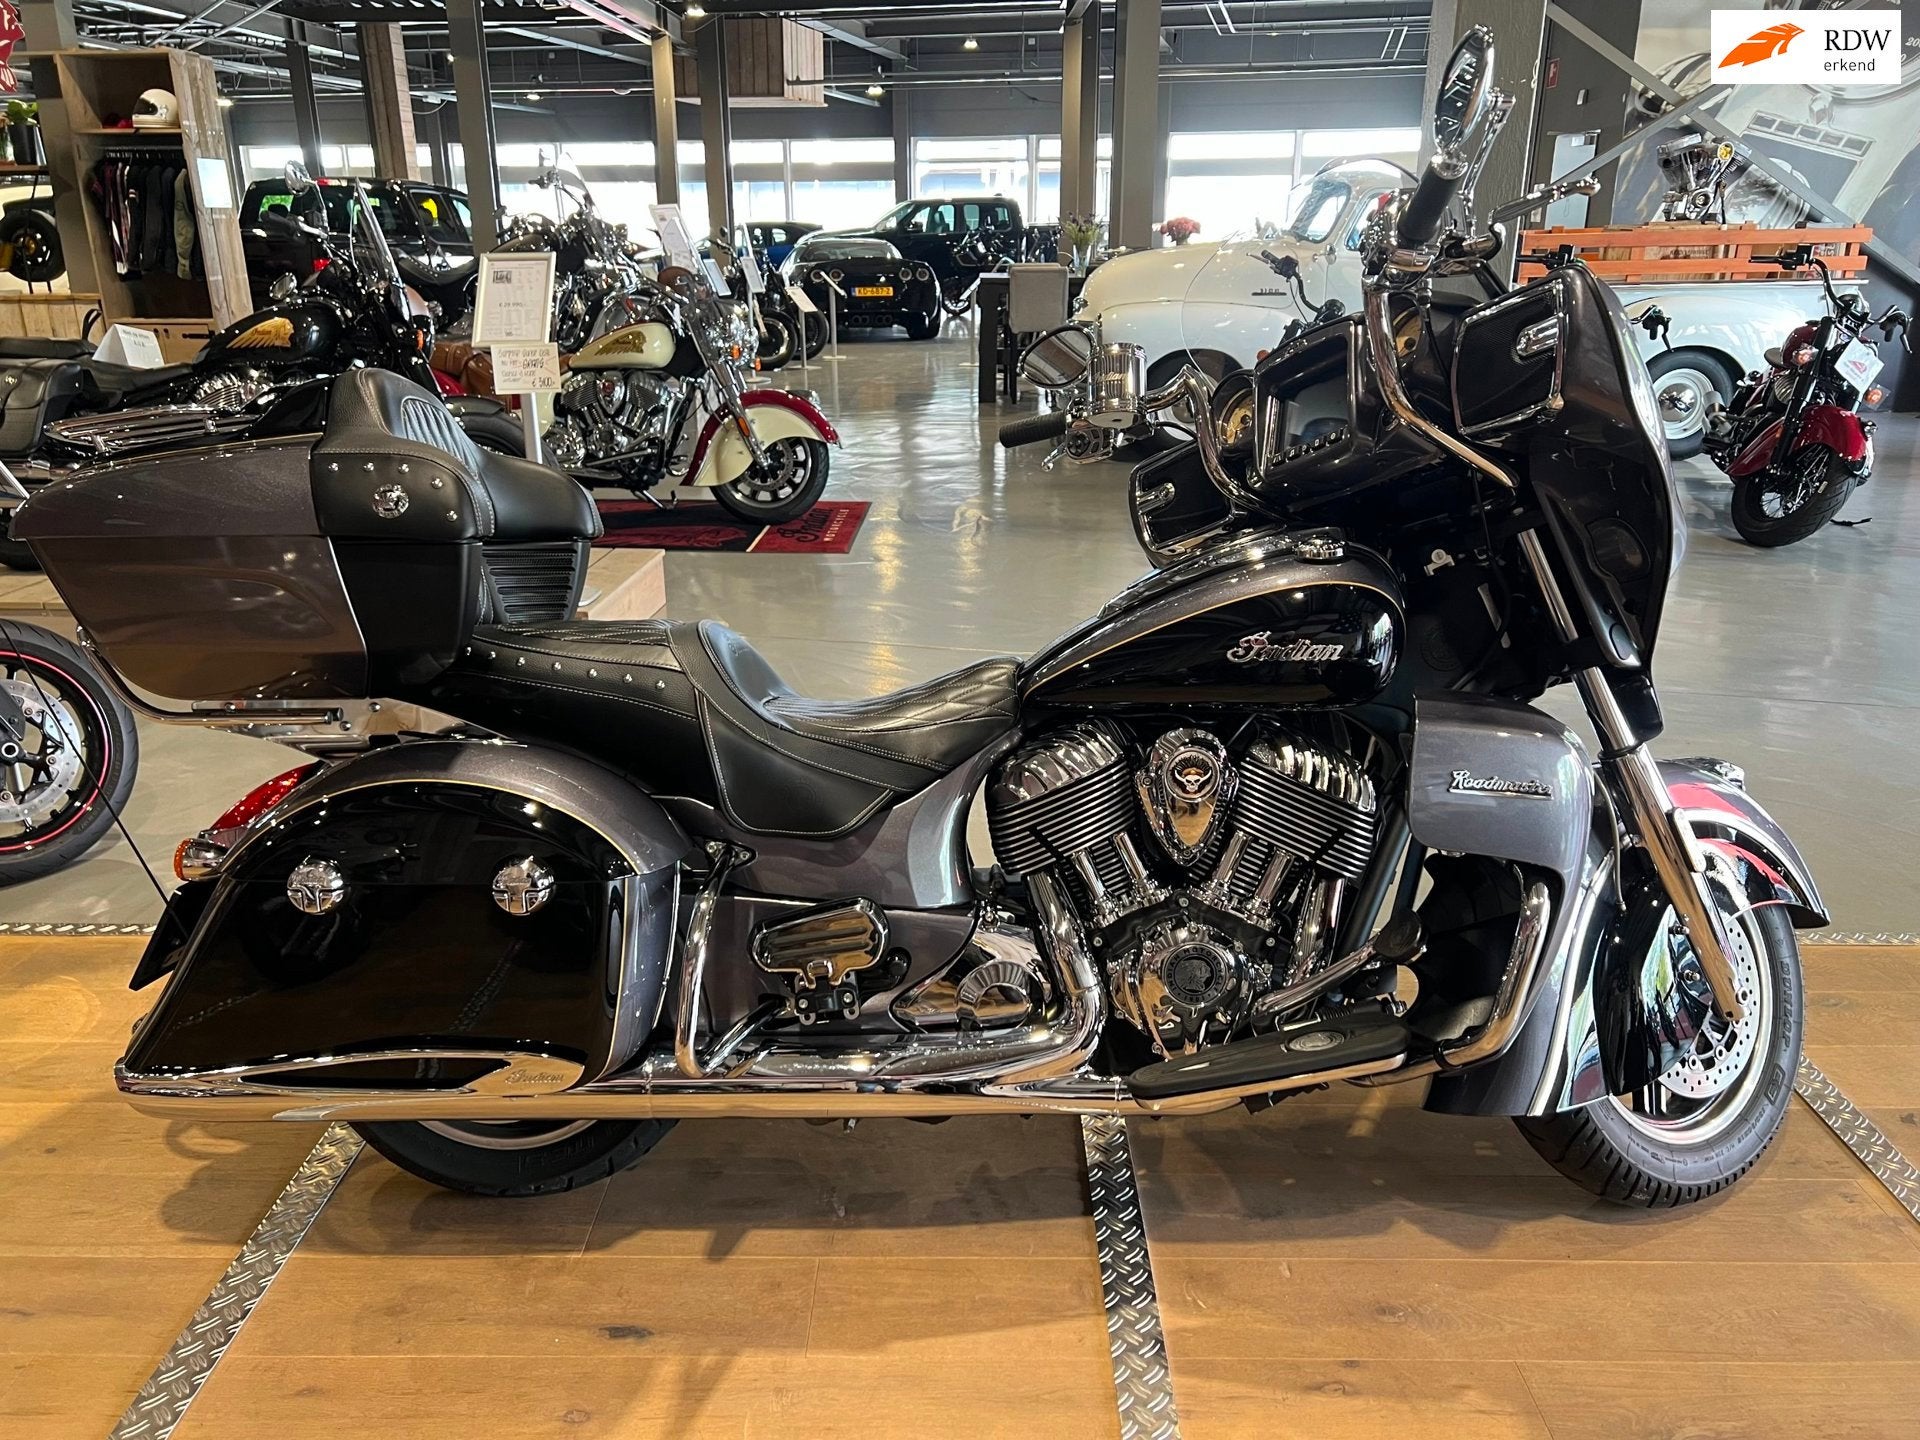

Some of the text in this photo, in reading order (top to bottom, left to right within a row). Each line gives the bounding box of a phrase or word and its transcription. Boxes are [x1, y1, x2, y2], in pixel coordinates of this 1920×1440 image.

[1226, 630, 1344, 663] Indian
[1451, 769, 1554, 795] Roadmaster
[1780, 960, 1793, 1048] DUNLOP
